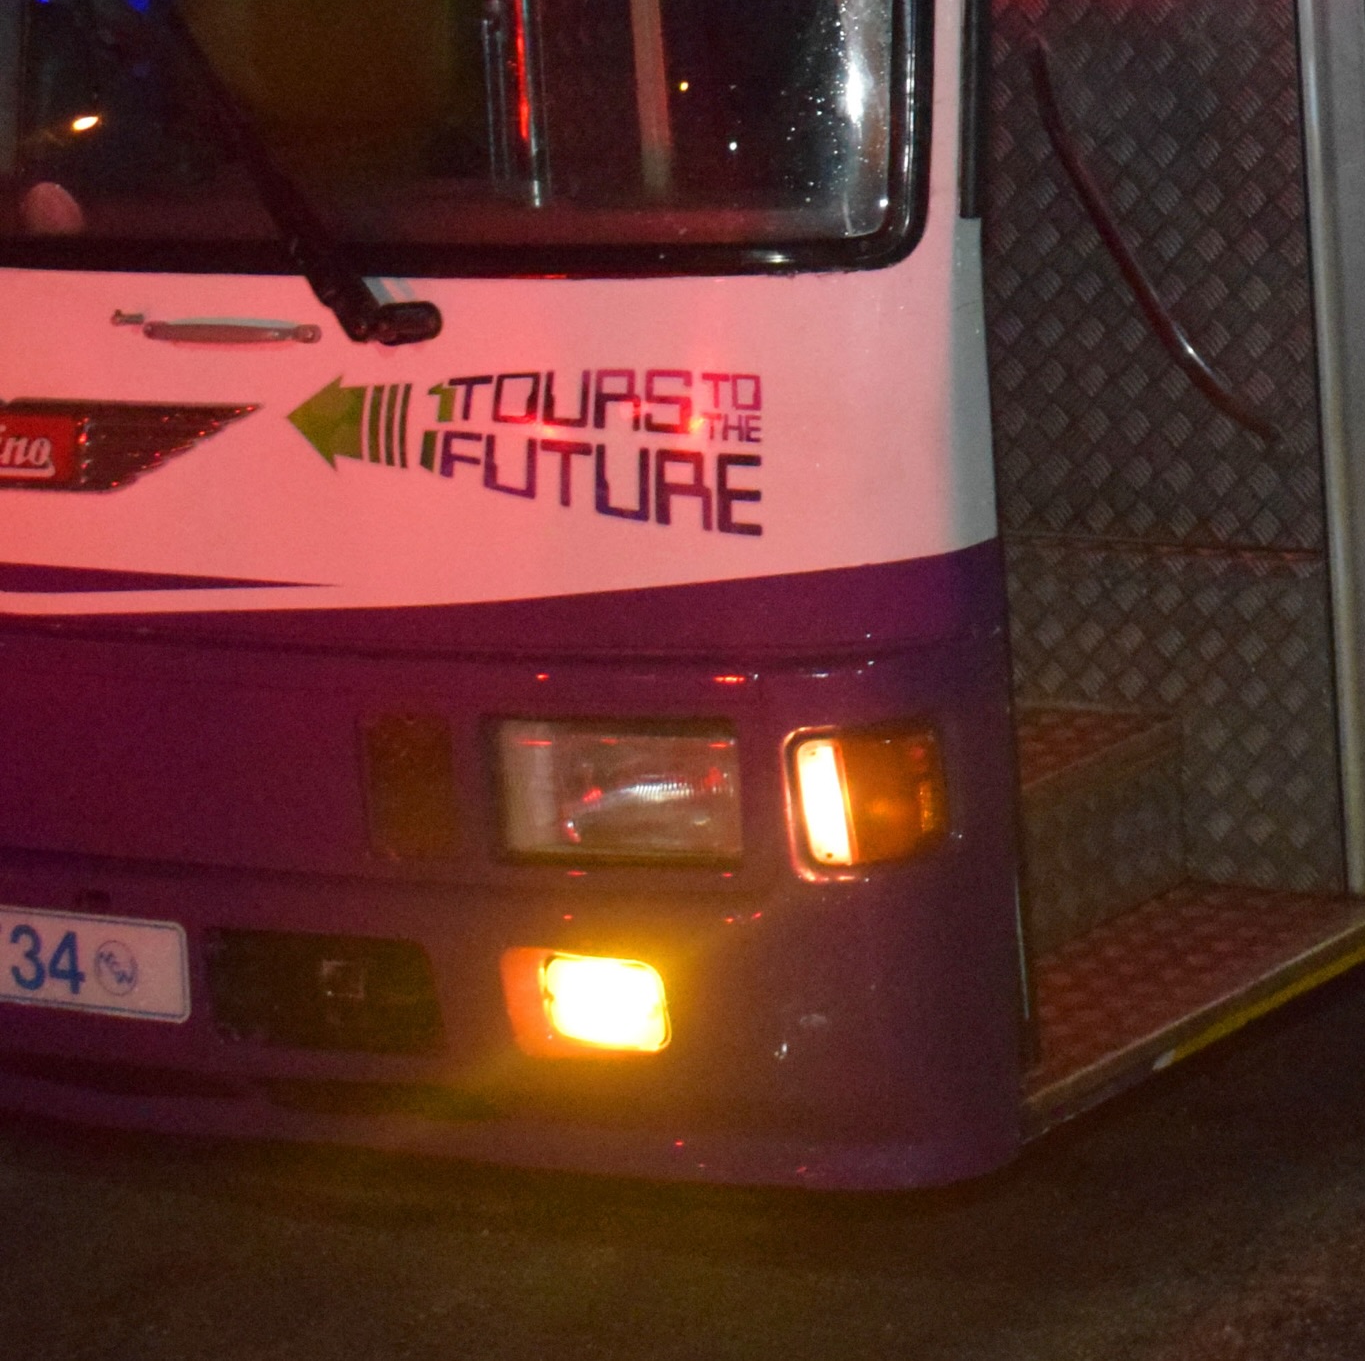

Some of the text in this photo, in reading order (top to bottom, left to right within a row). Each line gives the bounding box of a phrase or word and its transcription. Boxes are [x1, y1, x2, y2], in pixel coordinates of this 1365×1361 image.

[448, 369, 762, 435] TOURS TO
[702, 412, 762, 444] THE
[439, 429, 763, 537] FUTURE
